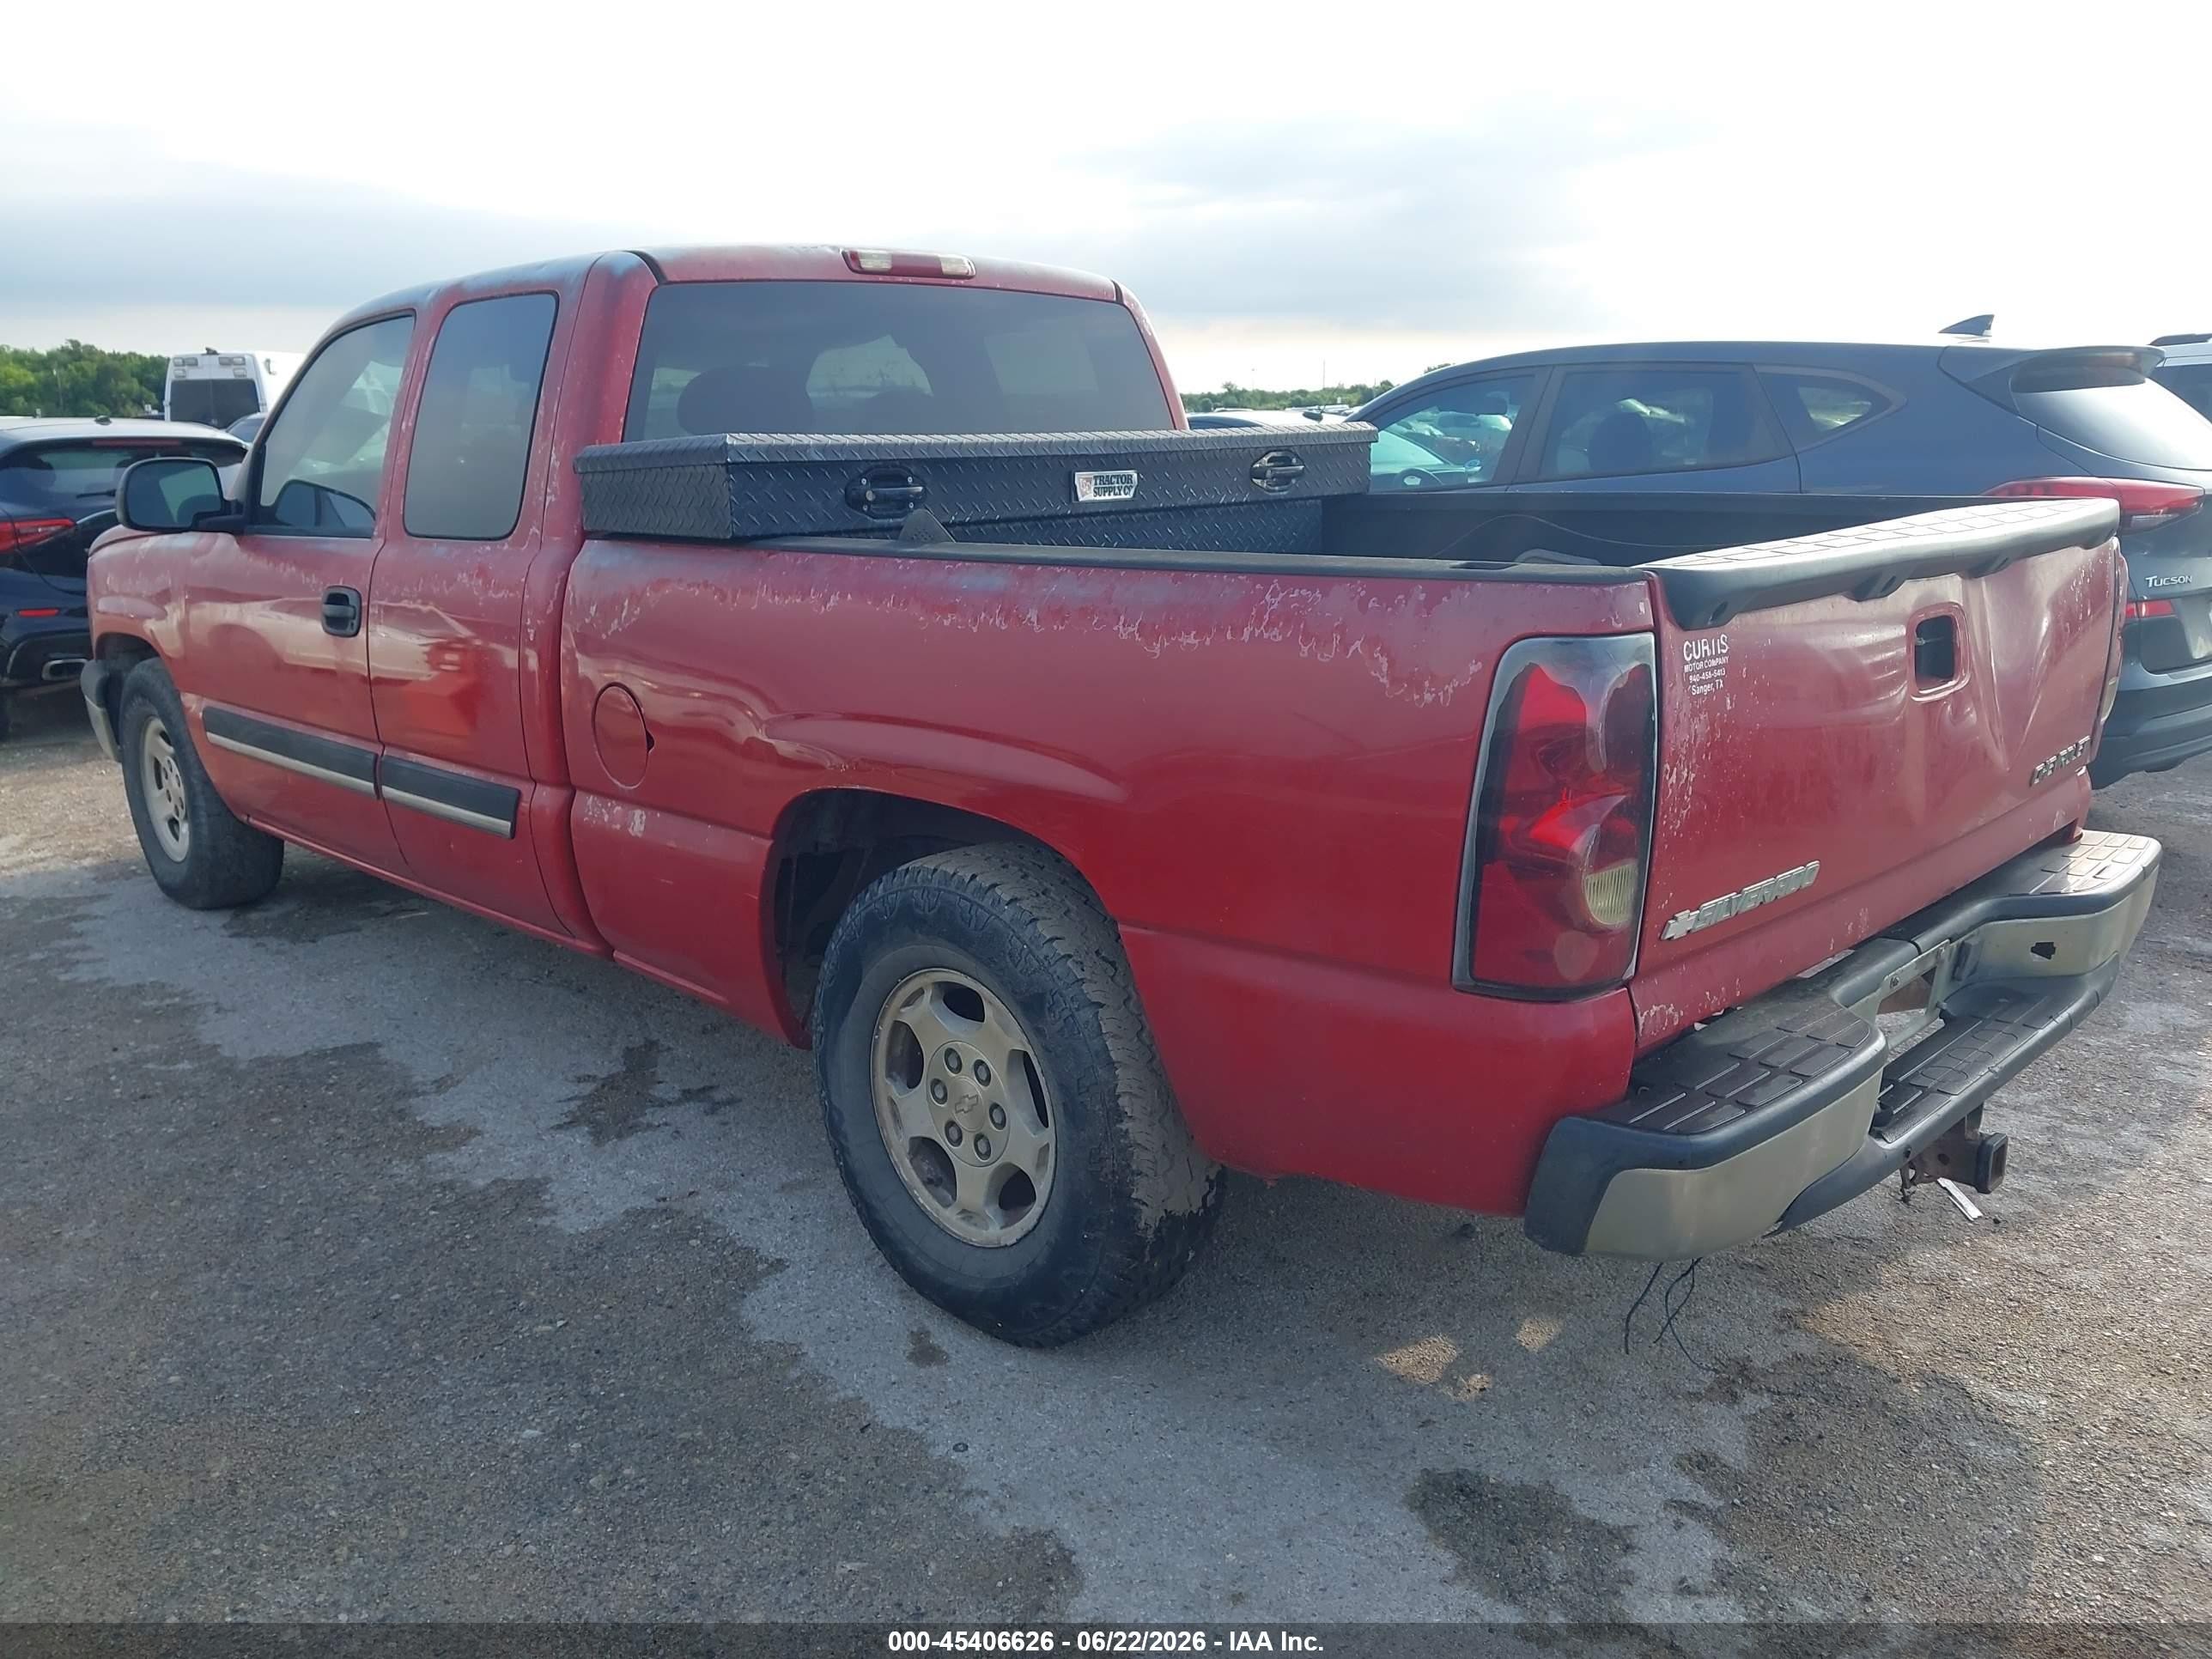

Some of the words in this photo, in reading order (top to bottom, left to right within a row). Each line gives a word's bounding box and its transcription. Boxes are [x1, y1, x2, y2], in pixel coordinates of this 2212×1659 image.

[1093, 473, 1133, 485] TRACTOR
[1093, 486, 1121, 497] SUPPLY
[1684, 660, 1704, 672] MOTOR
[1704, 655, 1729, 669] COMPANY
[1691, 682, 1715, 696] Sanger,
[1715, 678, 1723, 690] TX
[1691, 860, 1820, 933] SILVERADO
